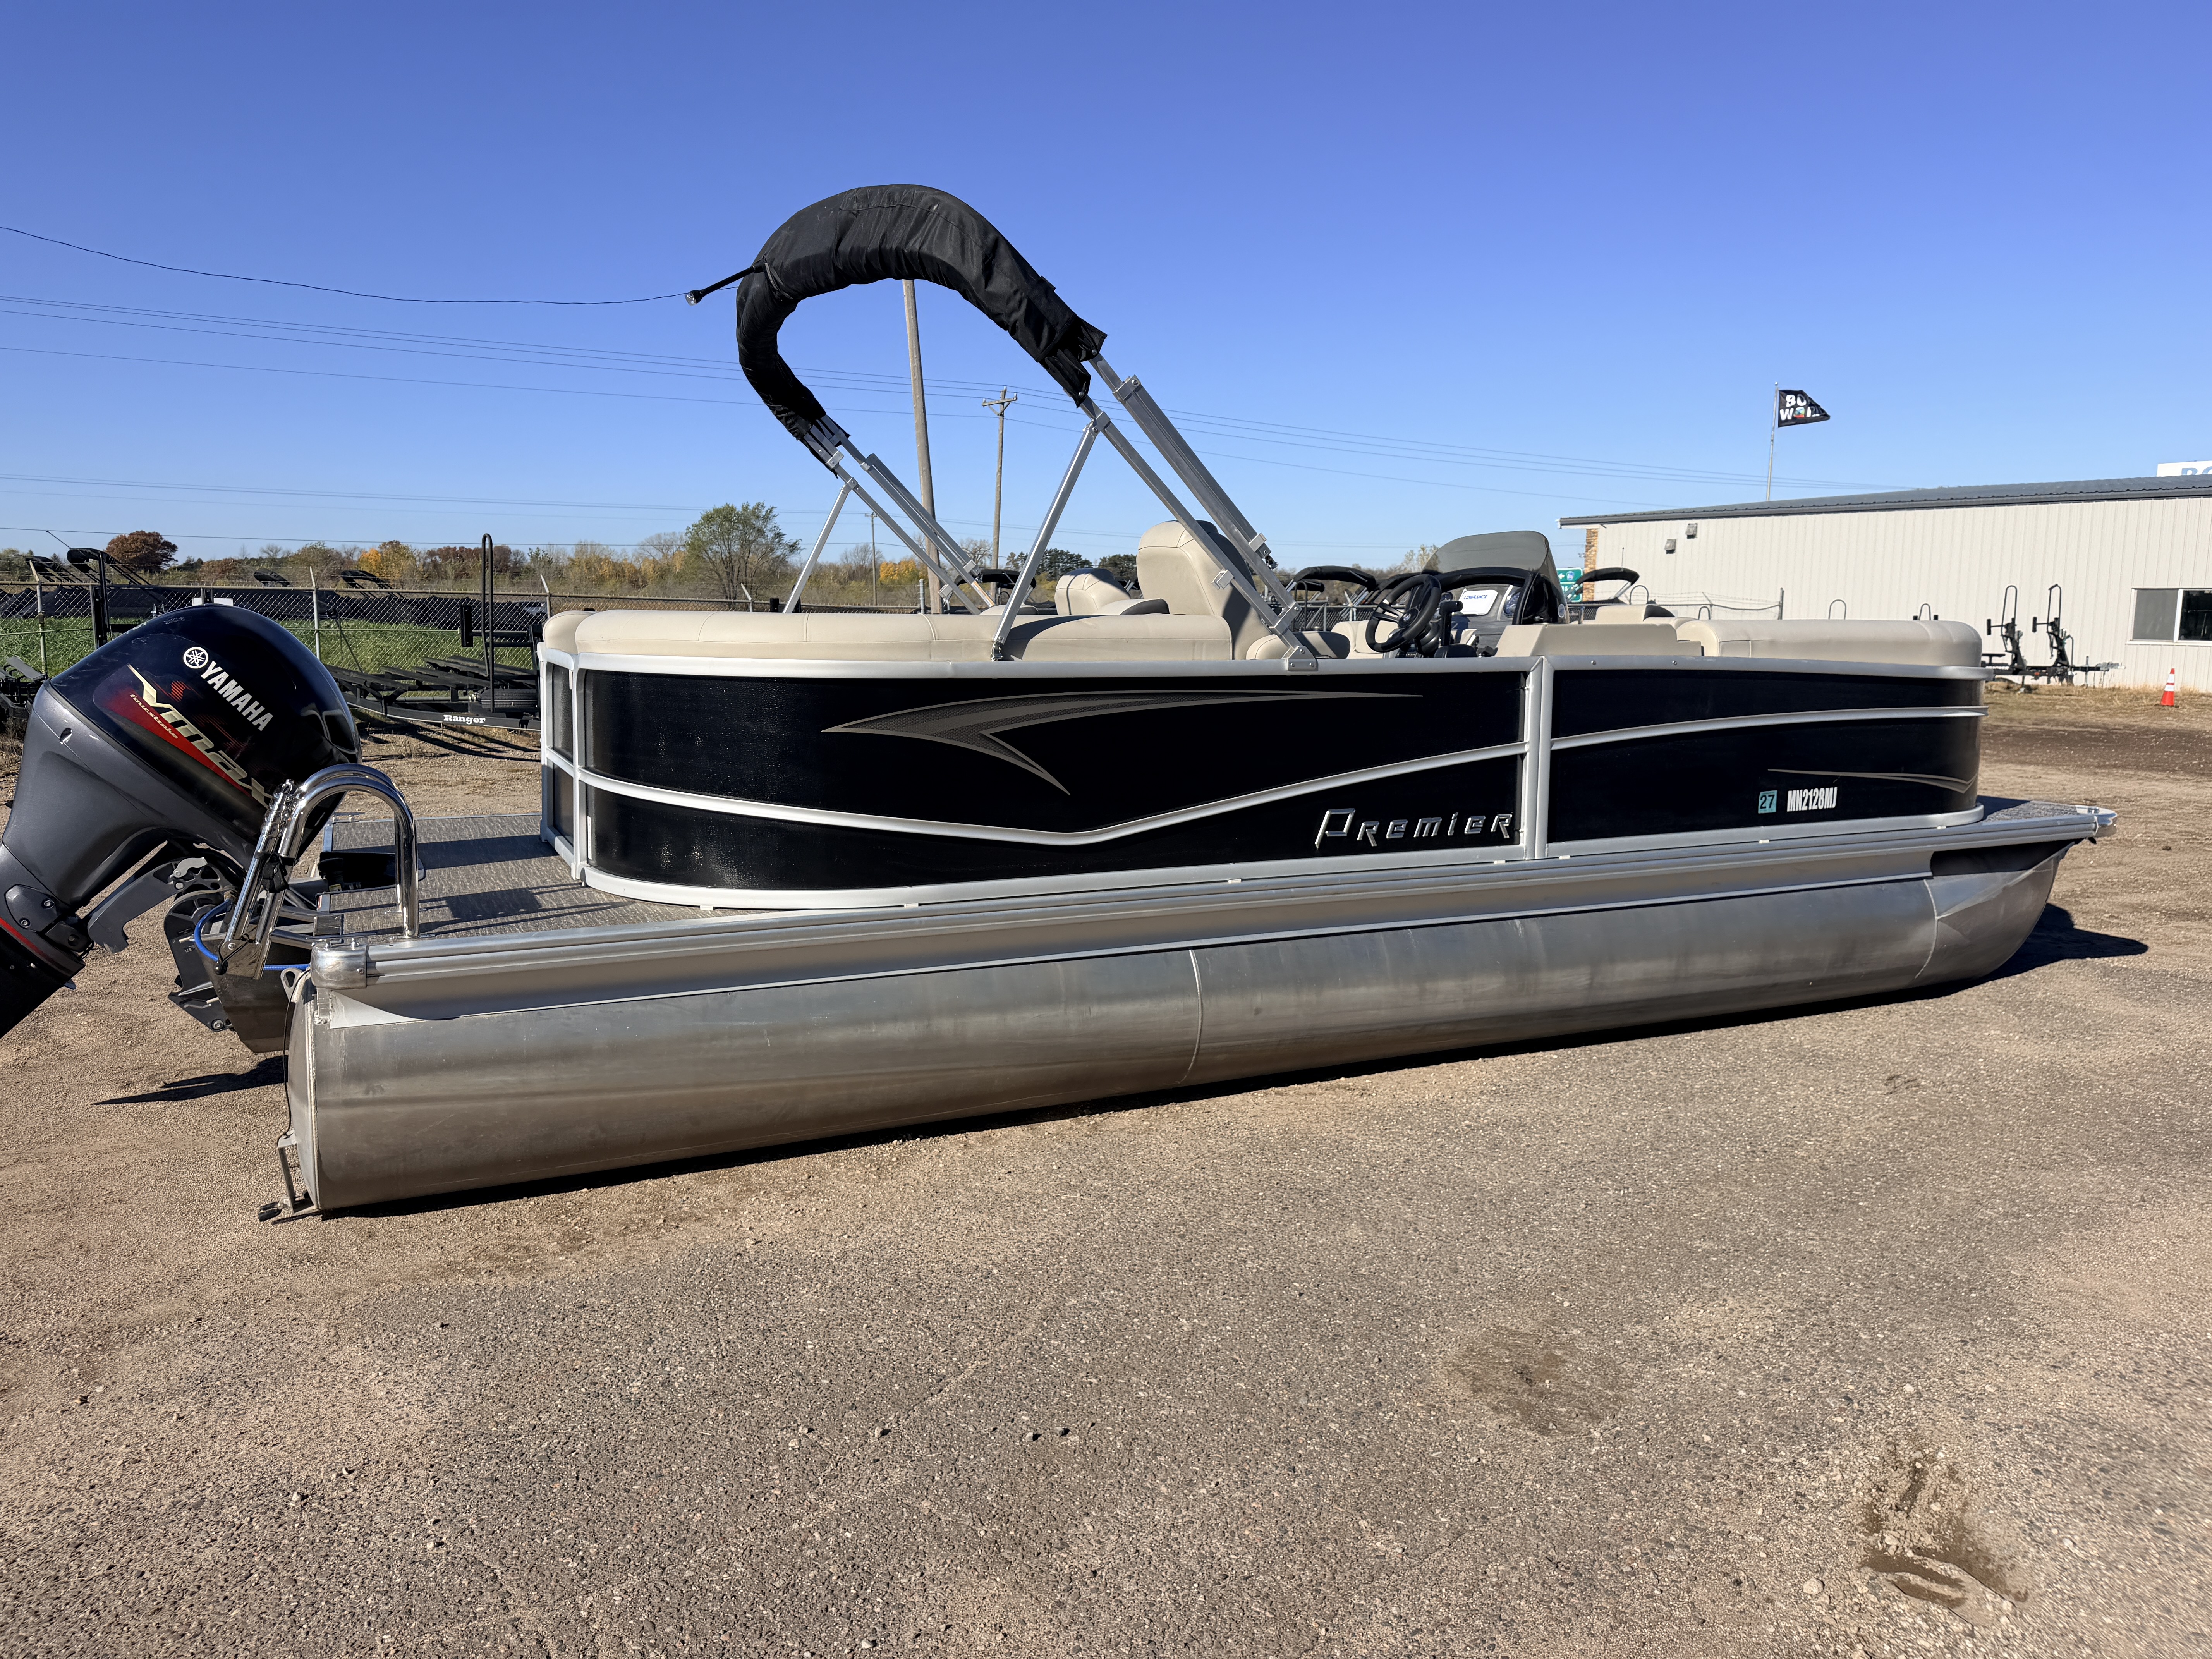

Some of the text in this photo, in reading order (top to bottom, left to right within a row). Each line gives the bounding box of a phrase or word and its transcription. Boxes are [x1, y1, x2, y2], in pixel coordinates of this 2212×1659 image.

[201, 661, 273, 731] YAMAHA
[129, 694, 178, 739] fourstroke
[443, 714, 486, 725] Ranger
[1760, 787, 1838, 812] 27 MN2128MJ
